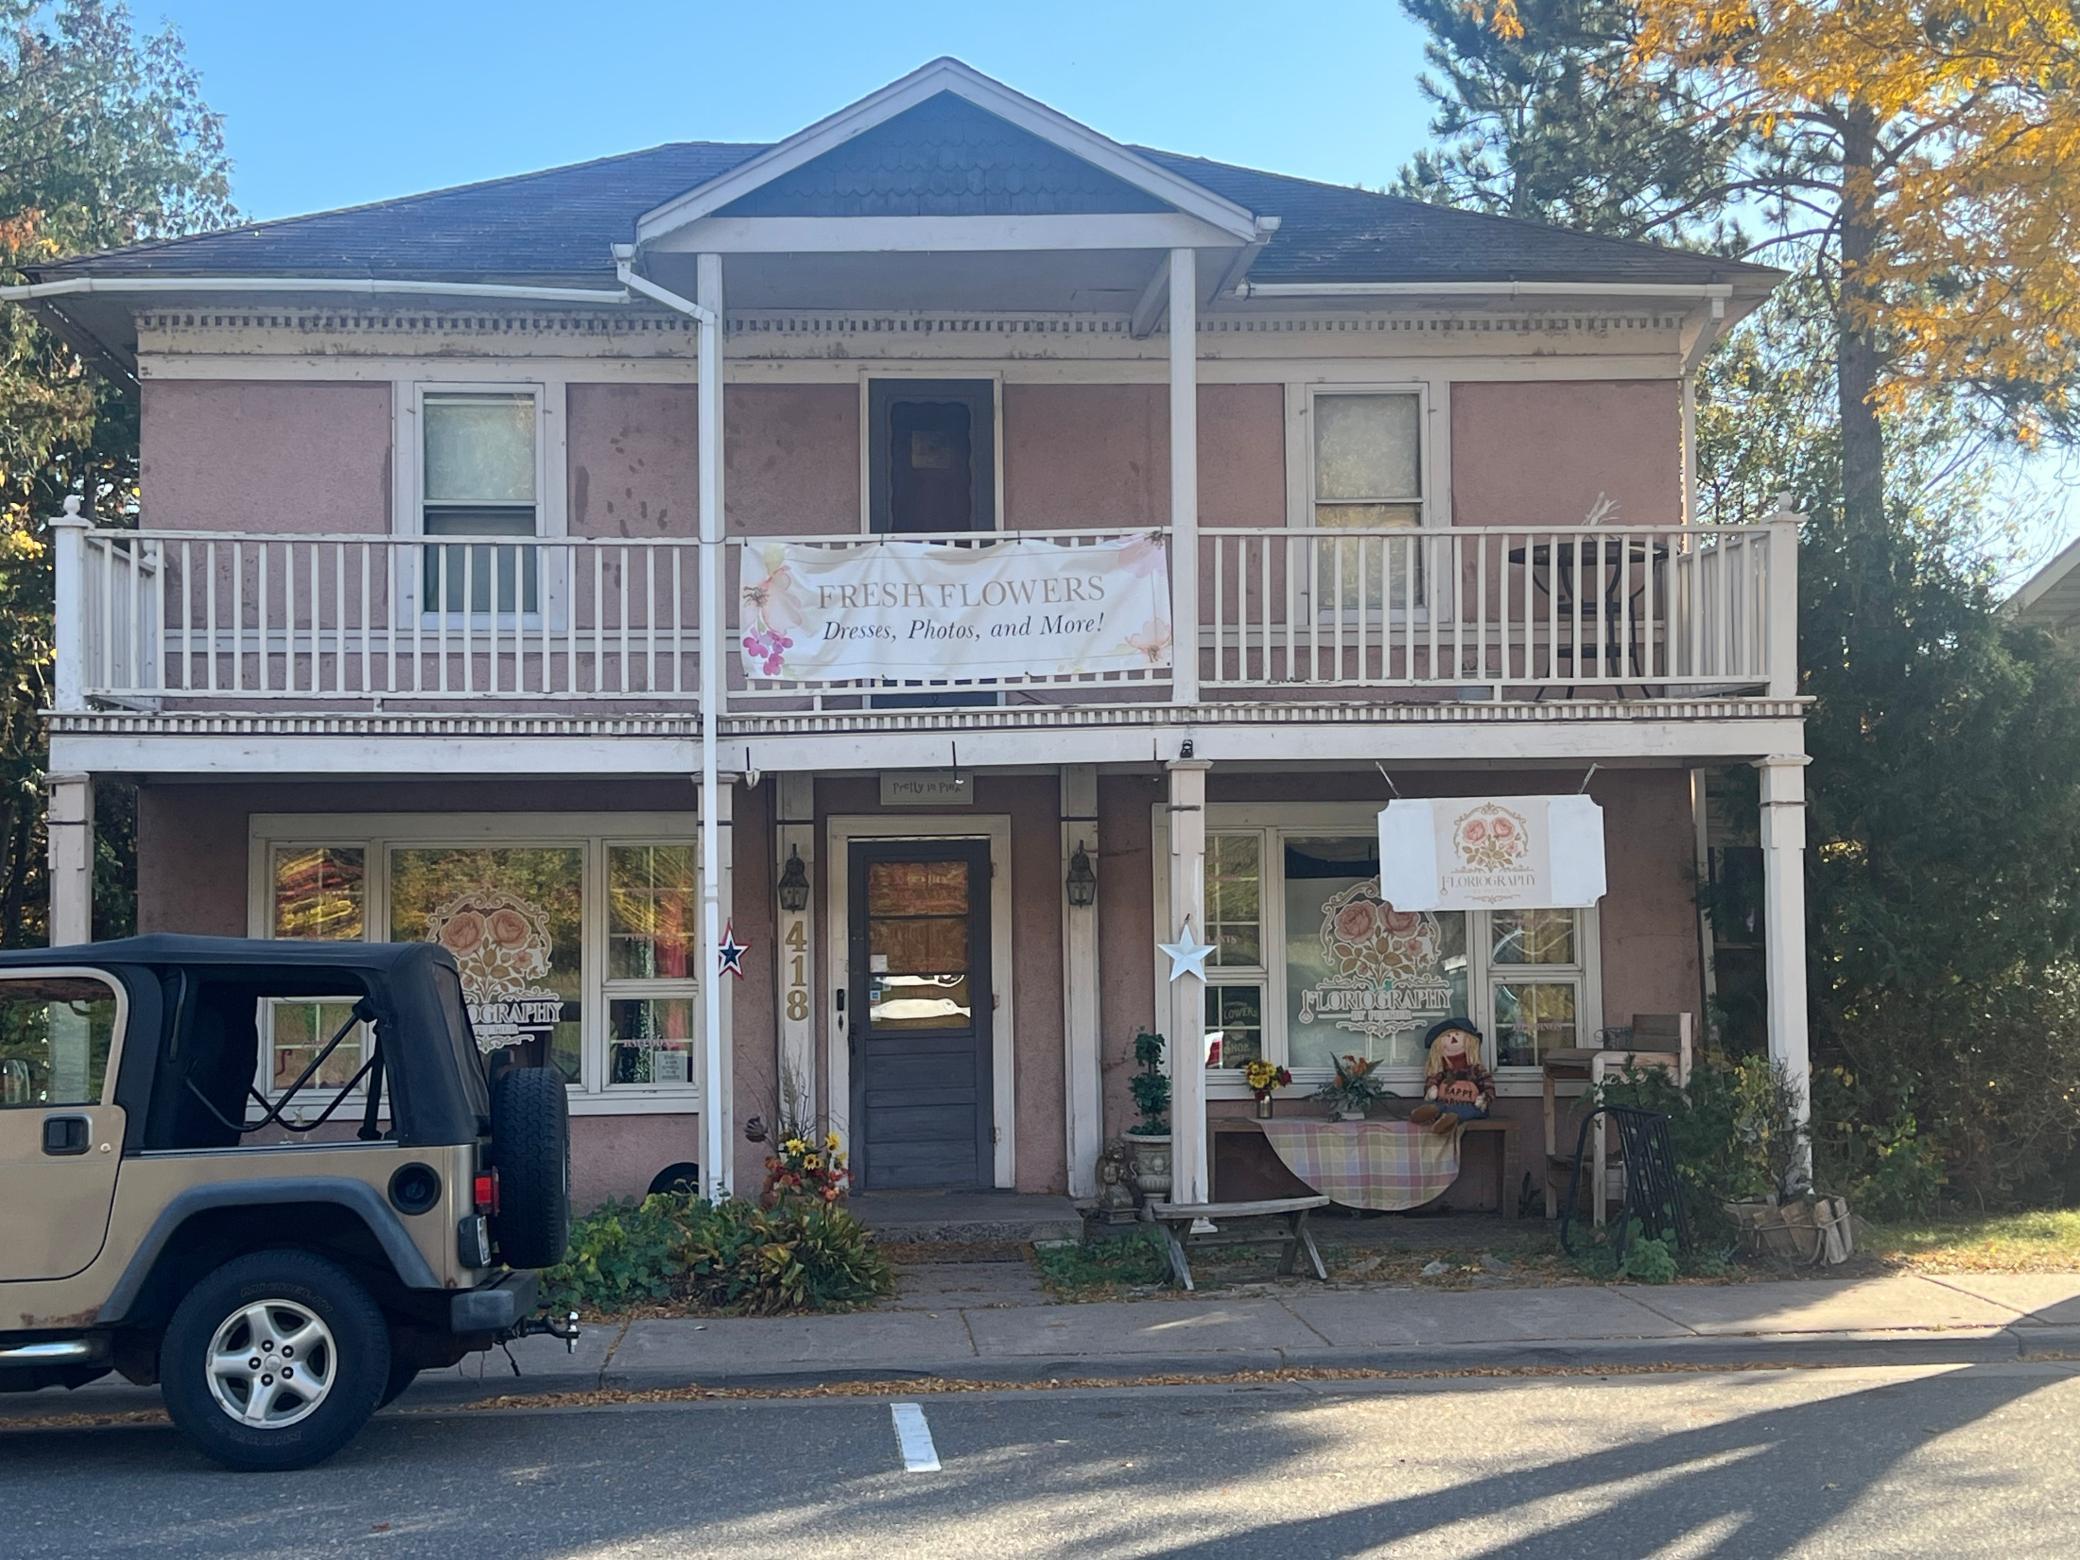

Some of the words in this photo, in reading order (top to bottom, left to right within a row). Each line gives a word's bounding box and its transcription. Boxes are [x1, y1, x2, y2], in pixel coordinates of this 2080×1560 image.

[818, 582, 926, 609] FRESH
[937, 575, 1105, 608] FLOWERS
[823, 620, 897, 642] Dresses,
[908, 618, 981, 642] Photos,
[990, 615, 1032, 637] and
[1040, 612, 1104, 635] More!
[1440, 875, 1536, 896] FLORIOGRAPHY
[785, 920, 809, 1021] 418
[467, 1002, 563, 1024] OGRAPHY
[1299, 989, 1453, 1024] FLORIOGRAPHY
